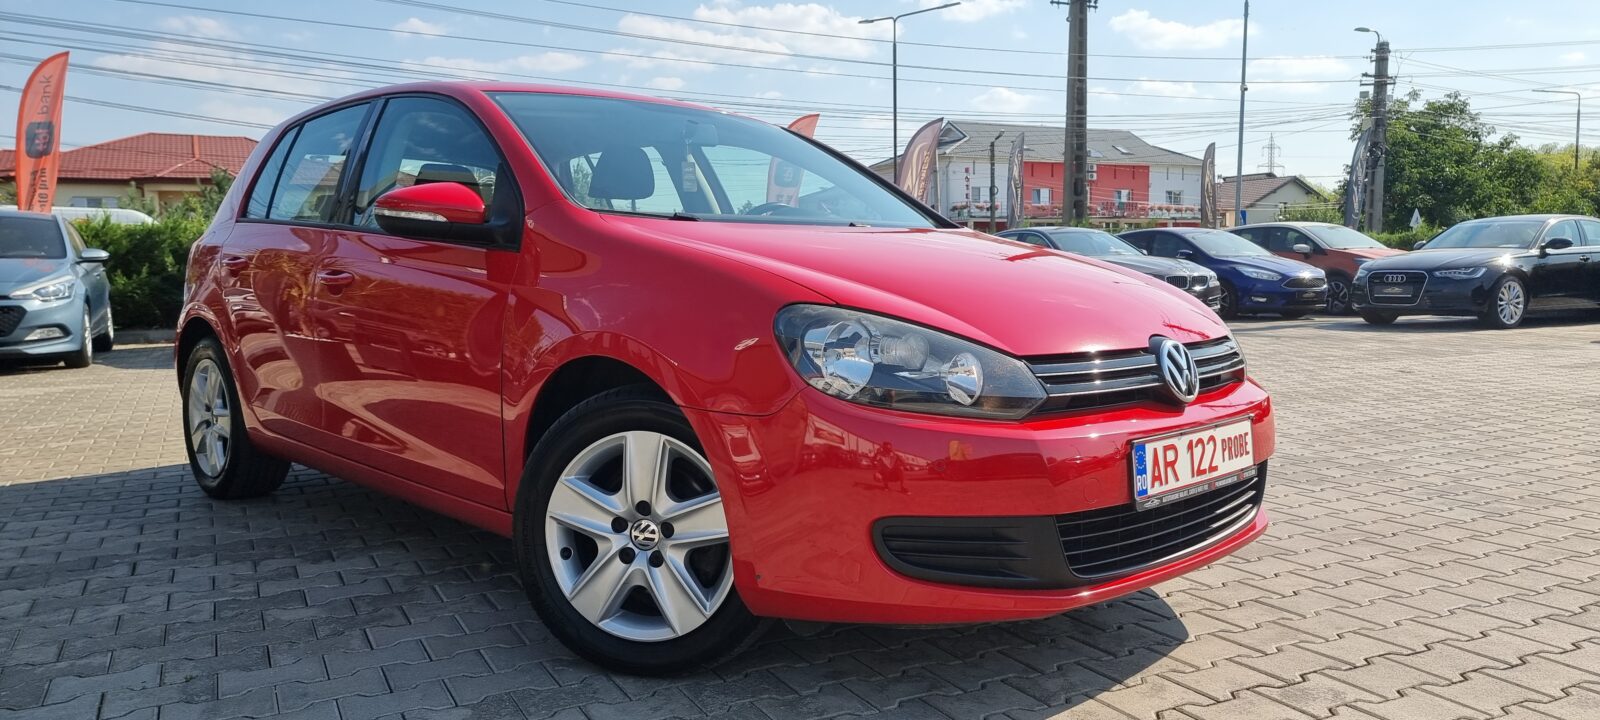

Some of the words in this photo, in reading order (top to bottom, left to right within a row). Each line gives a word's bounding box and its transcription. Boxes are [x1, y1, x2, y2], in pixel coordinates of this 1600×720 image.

[37, 74, 53, 115] bank
[1161, 339, 1199, 402] VW
[1137, 474, 1147, 491] RO
[1150, 443, 1179, 489] AR
[1187, 435, 1219, 478] 122
[1220, 432, 1250, 463] PROBE
